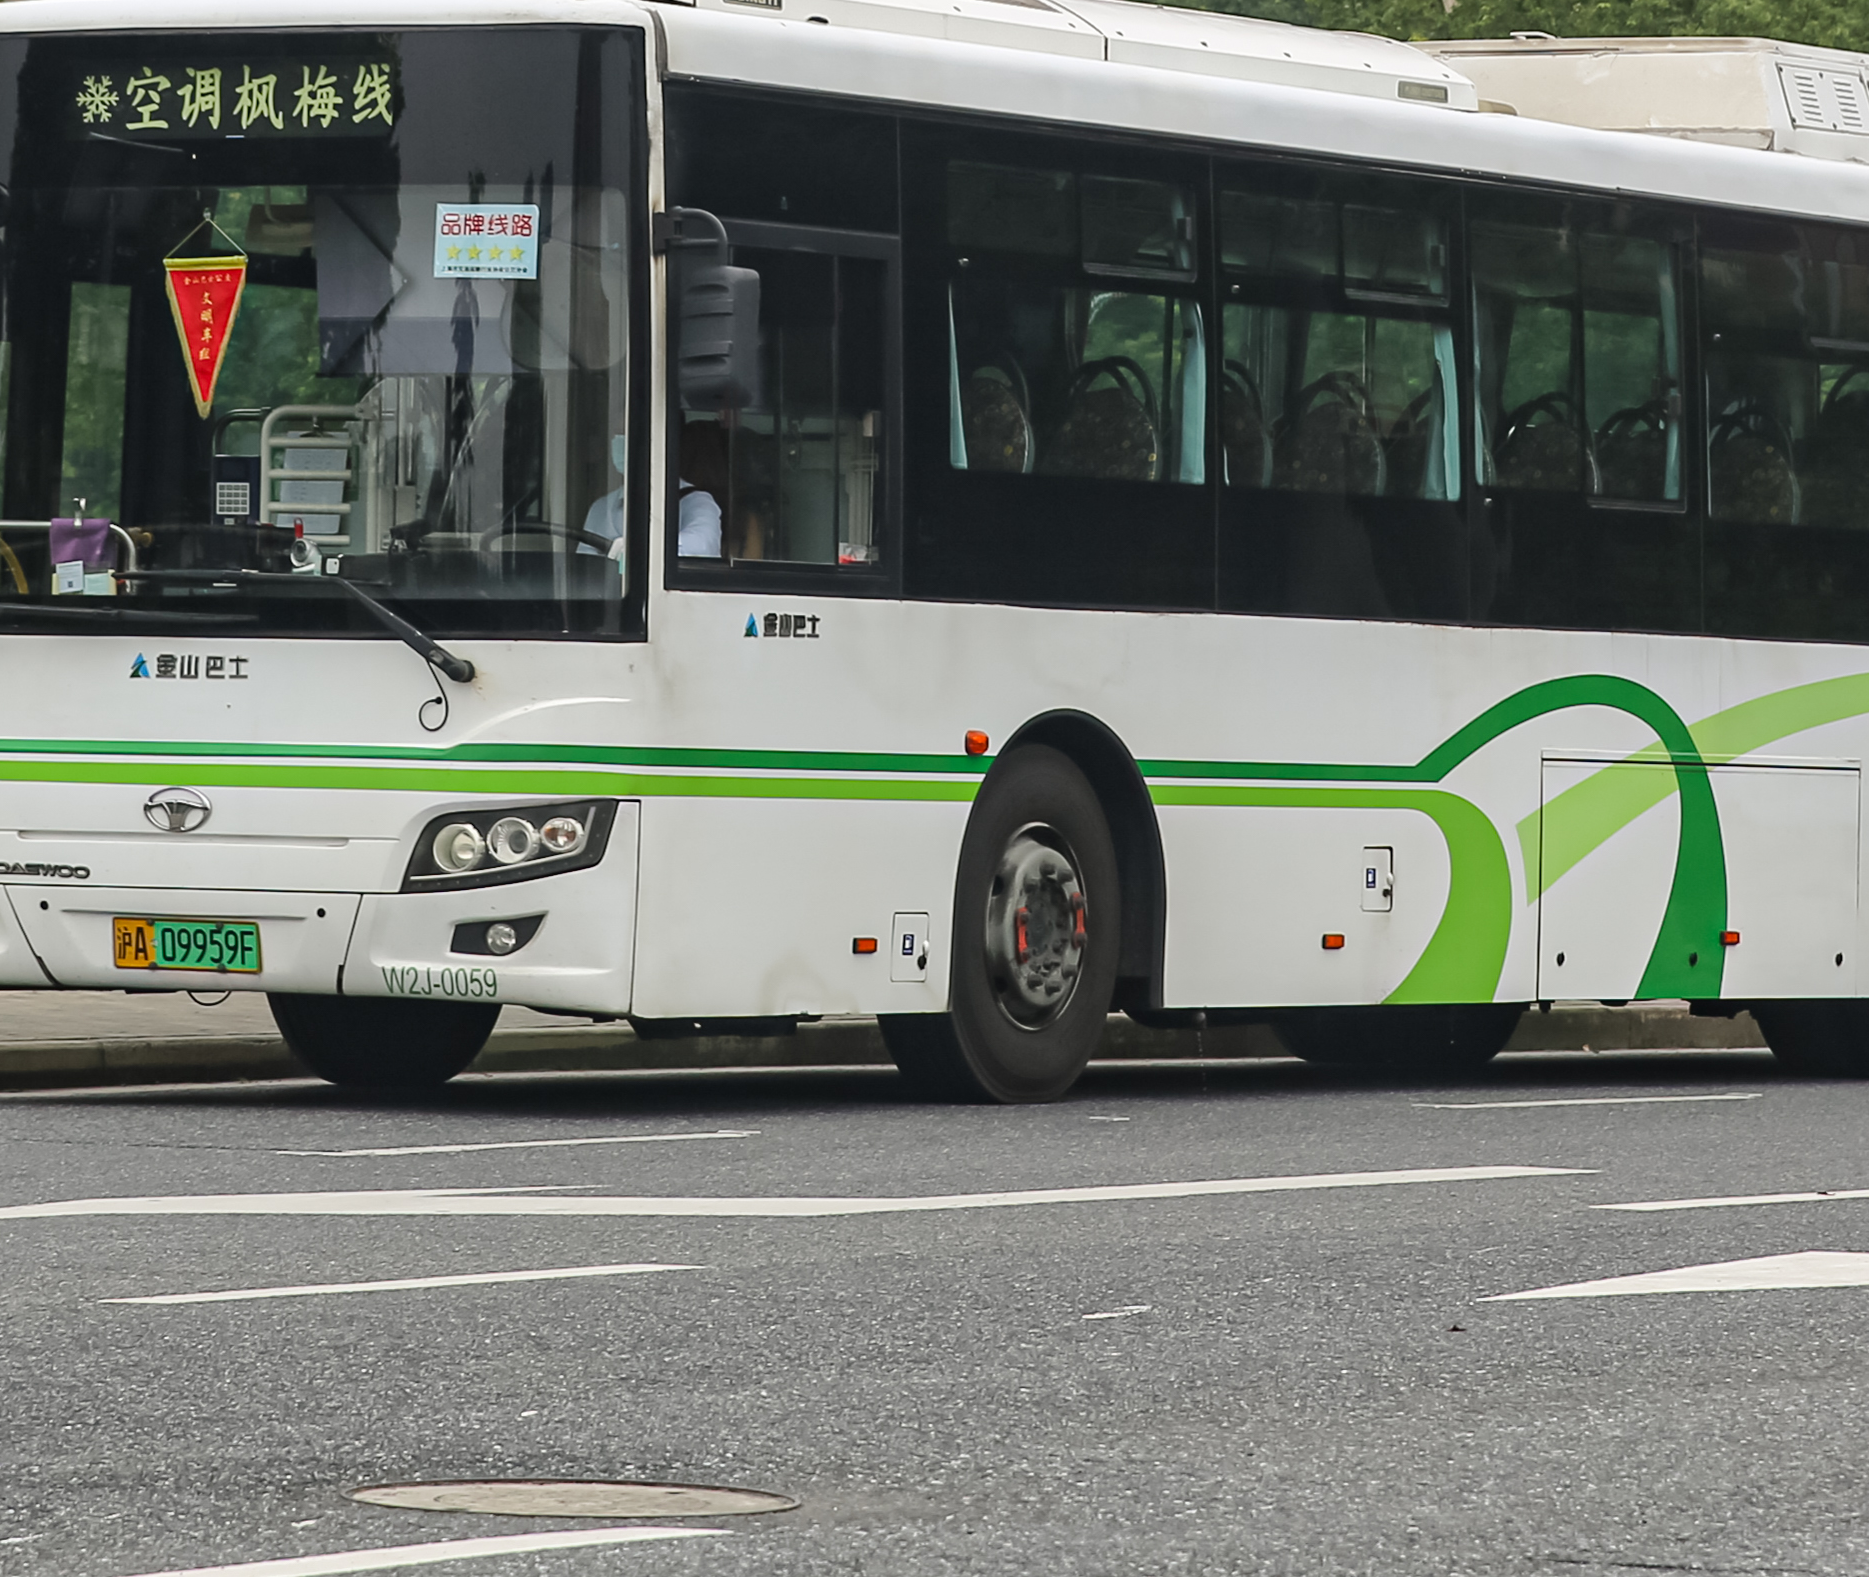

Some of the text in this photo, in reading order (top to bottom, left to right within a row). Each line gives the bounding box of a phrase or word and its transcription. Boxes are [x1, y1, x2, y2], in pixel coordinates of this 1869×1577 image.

[126, 64, 393, 130] 空调枫梅线
[441, 213, 533, 237] 品牌线路
[763, 613, 820, 638] 金山巴士
[155, 654, 249, 679] 金山巴士
[161, 927, 255, 966] 09959F
[381, 965, 497, 998] W2J-0059
